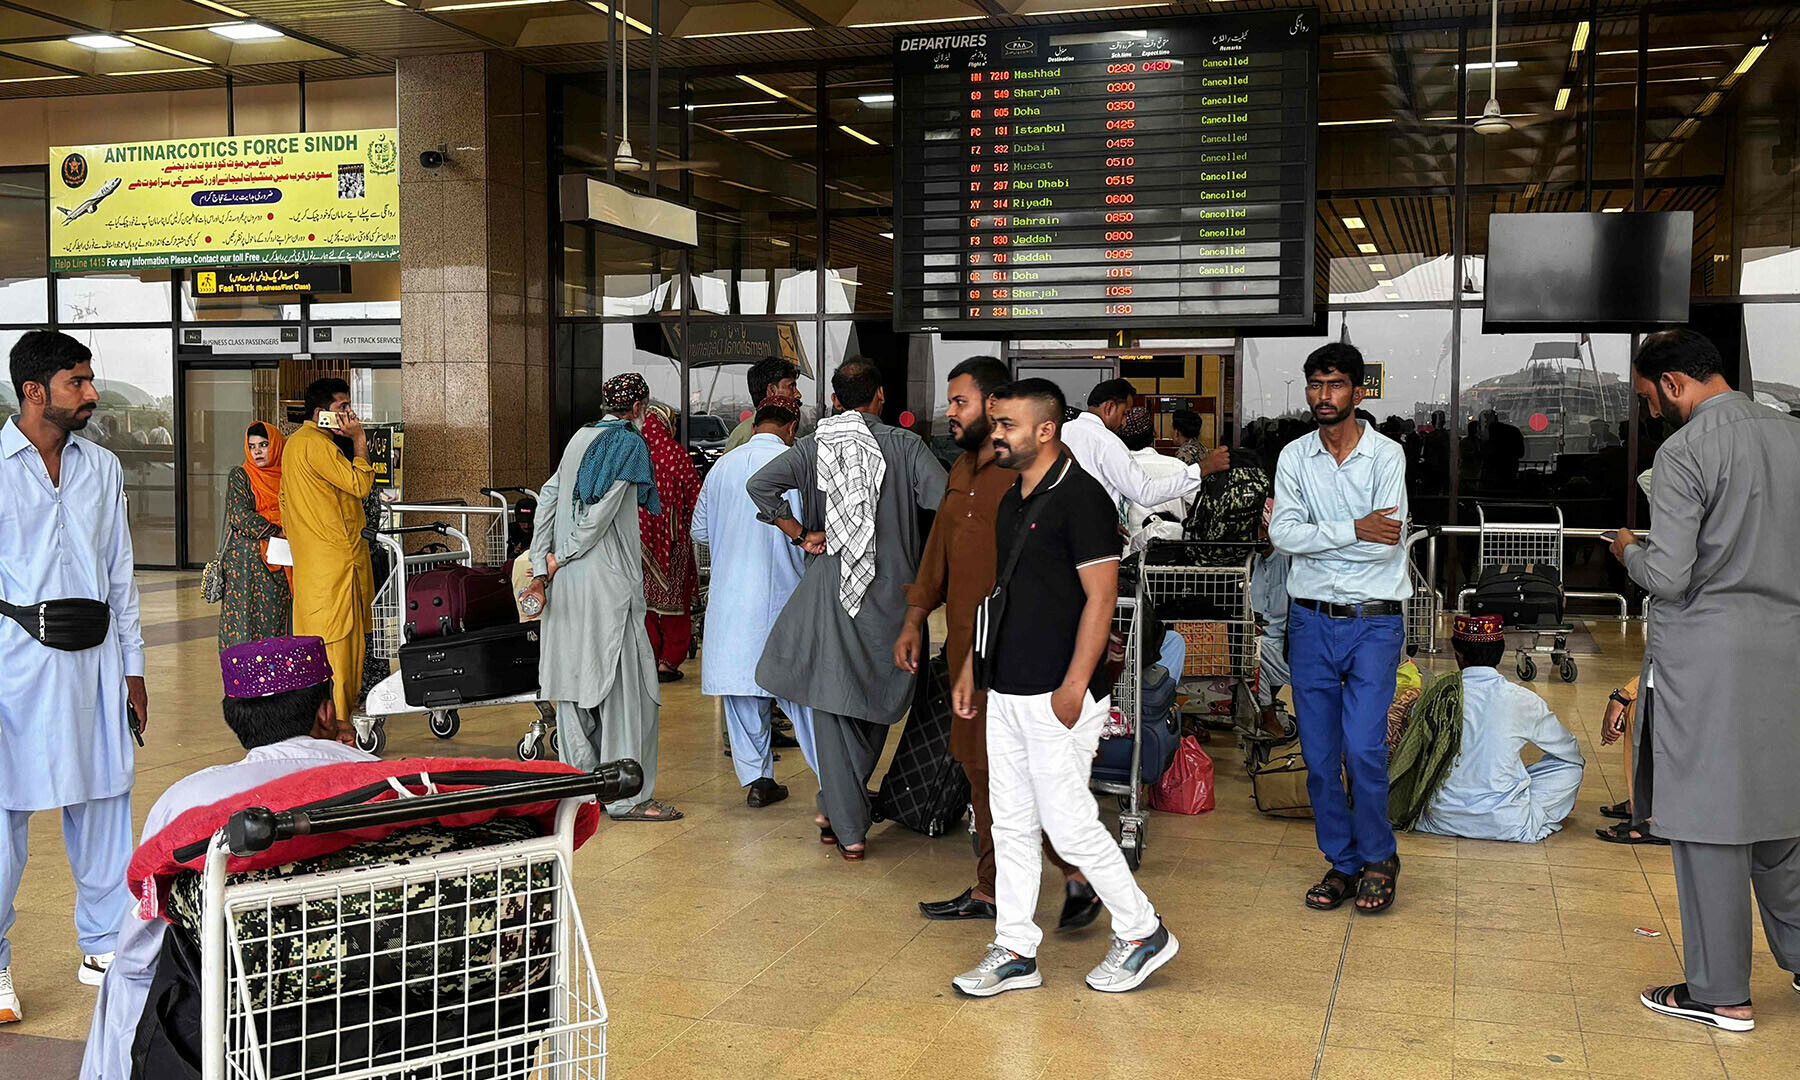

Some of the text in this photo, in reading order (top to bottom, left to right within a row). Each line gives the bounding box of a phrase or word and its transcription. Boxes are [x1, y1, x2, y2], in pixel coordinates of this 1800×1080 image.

[900, 34, 987, 51] DEPARTURES
[1014, 68, 1061, 79] Mashhad
[1107, 64, 1136, 73] 0230
[1142, 61, 1172, 71] 0430
[1202, 57, 1249, 68] Cancelled
[994, 89, 1010, 99] 549
[1013, 88, 1061, 99] Sharjah
[1106, 83, 1136, 92] 0300
[1202, 77, 1248, 87] Cancelled
[994, 108, 1010, 118] 605
[1014, 107, 1040, 116] Doha
[1106, 101, 1136, 111] 0350
[1202, 95, 1248, 106] Cancelled
[971, 114, 1247, 136] PC 131 Istanbul 0425 Cancelled
[104, 134, 358, 163] ANTINARCOTICS FORCE SINDH
[971, 133, 1247, 155] FZ 332 Dubai 0455 Cancelled
[994, 163, 1009, 172] 512
[1013, 161, 1053, 171] Muscat
[1105, 157, 1135, 167] 0510
[1201, 152, 1247, 163] Cancelled
[971, 171, 1247, 191] EY 297 Abu Dhabi 0515 Cancelled
[970, 190, 1247, 209] XY 314 Riyadh 0600 Cancelled
[993, 217, 1007, 227] 751
[1013, 216, 1060, 226] Bahrain
[1105, 213, 1134, 222] 0650
[1200, 209, 1246, 219] Cancelled
[970, 236, 981, 246] F3
[993, 235, 1008, 245] 830
[1105, 231, 1133, 241] 0800
[1200, 228, 1246, 238] Cancelled
[55, 258, 72, 269] Help
[72, 258, 88, 268] Line
[90, 257, 107, 267] 1415
[106, 257, 118, 267] For
[117, 258, 131, 268] any
[131, 256, 170, 266] Information
[170, 255, 192, 265] Please
[193, 253, 220, 264] Contact
[219, 255, 232, 263] our
[244, 252, 260, 262] Free
[970, 246, 1245, 263] SV 701 Jeddah 0905 Cancelled
[992, 271, 1007, 280] 611
[1012, 271, 1039, 280] Doha
[1105, 268, 1133, 278] 1015
[1199, 265, 1245, 275] Cancelled
[219, 284, 234, 293] Fast
[235, 283, 255, 292] Track
[293, 283, 311, 291] Class)
[1012, 288, 1058, 299] Sharjah
[1105, 286, 1133, 296] 1035
[970, 307, 980, 317] FZ
[1012, 307, 1044, 316] Dubai
[1105, 304, 1133, 315] 1130
[228, 338, 245, 346] CLASS
[245, 337, 279, 346] PASSENGERS
[357, 336, 376, 344] TRACK
[1116, 330, 1124, 347] 1
[1364, 388, 1379, 397] ATE
